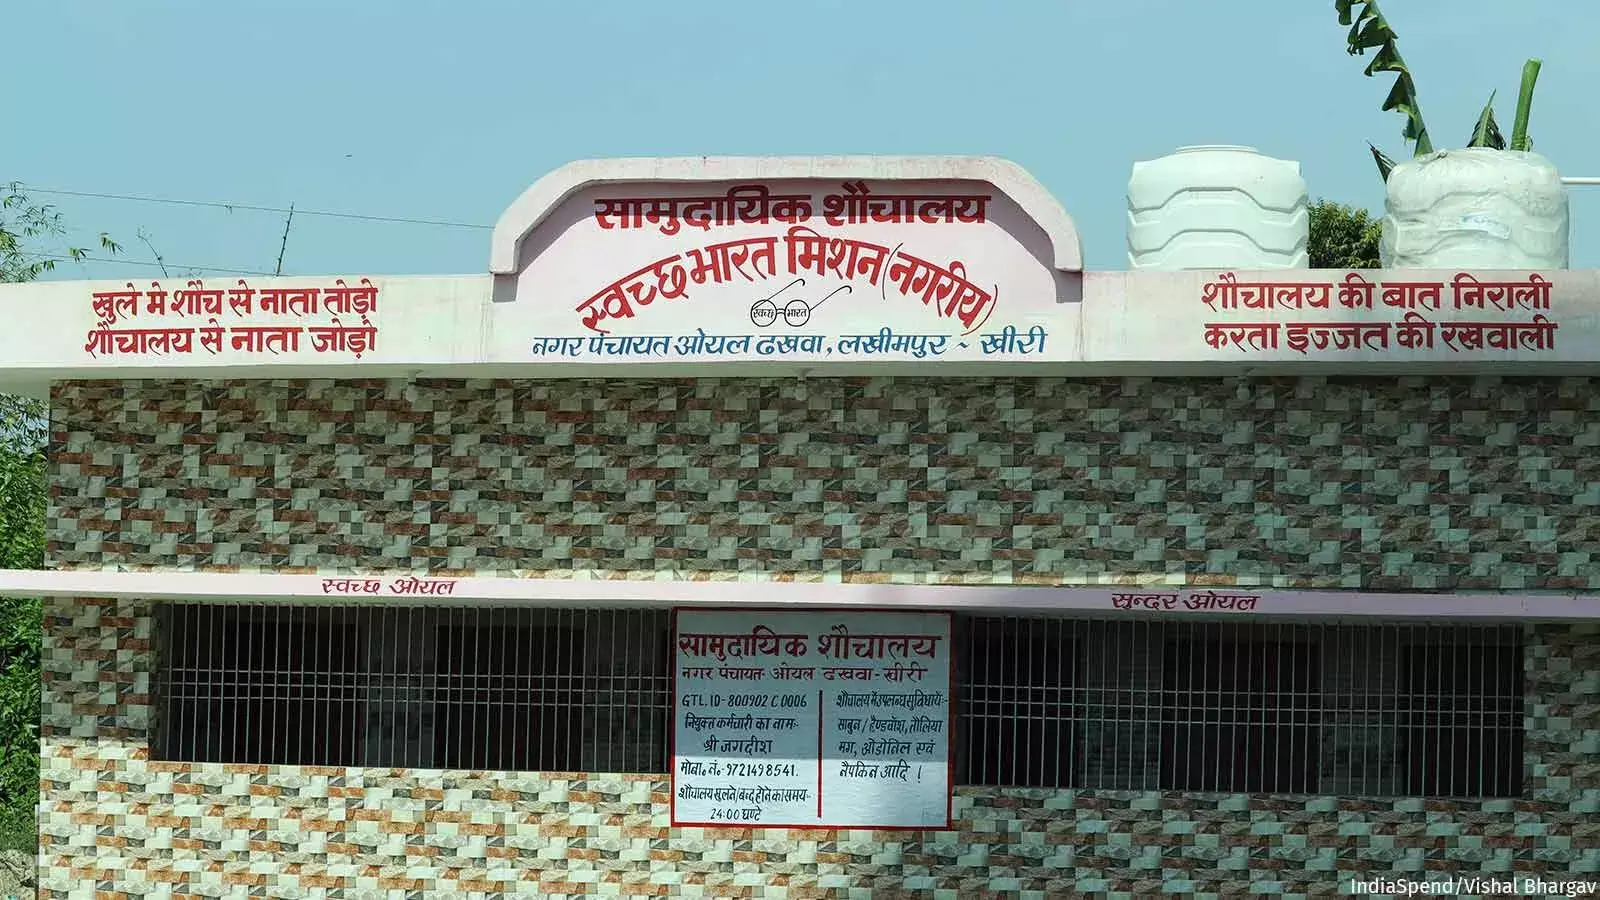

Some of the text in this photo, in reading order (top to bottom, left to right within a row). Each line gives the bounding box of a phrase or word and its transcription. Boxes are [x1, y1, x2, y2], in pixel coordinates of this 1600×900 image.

[594, 182, 992, 235] सामुदायिक शौचालय
[576, 226, 999, 336] स्वच्छ भारत मिशन (नगरीय)
[1201, 272, 1554, 312] शौचालय की बात निराली
[91, 278, 379, 325] खुले मे शौच से नाता तोड़ो
[786, 308, 807, 318] भारत
[84, 317, 378, 359] शौचालय से नाता जोड़ो
[532, 336, 585, 357] नगर
[588, 332, 672, 357] पंचायत
[673, 328, 753, 356] ओयल
[838, 327, 952, 358] लखीमपुर
[979, 324, 1048, 354] खीरी
[1203, 311, 1560, 354] करता इज्जत की रखवाली
[321, 576, 457, 595] स्वच्छ ओयल
[1111, 590, 1262, 611] सुन्दर ओयल
[678, 624, 943, 661] सामुदायिक शौचालय
[681, 667, 714, 680] नगर
[769, 661, 817, 681] ओयल
[882, 661, 929, 683] खीरी
[755, 717, 771, 731] का
[909, 715, 944, 733] तौलिया
[703, 734, 773, 755] श्री जगदीश
[839, 741, 857, 757] मग,
[916, 739, 936, 754] एवं
[880, 759, 911, 782] आदि
[710, 805, 763, 821] 24:00 घण्टे
